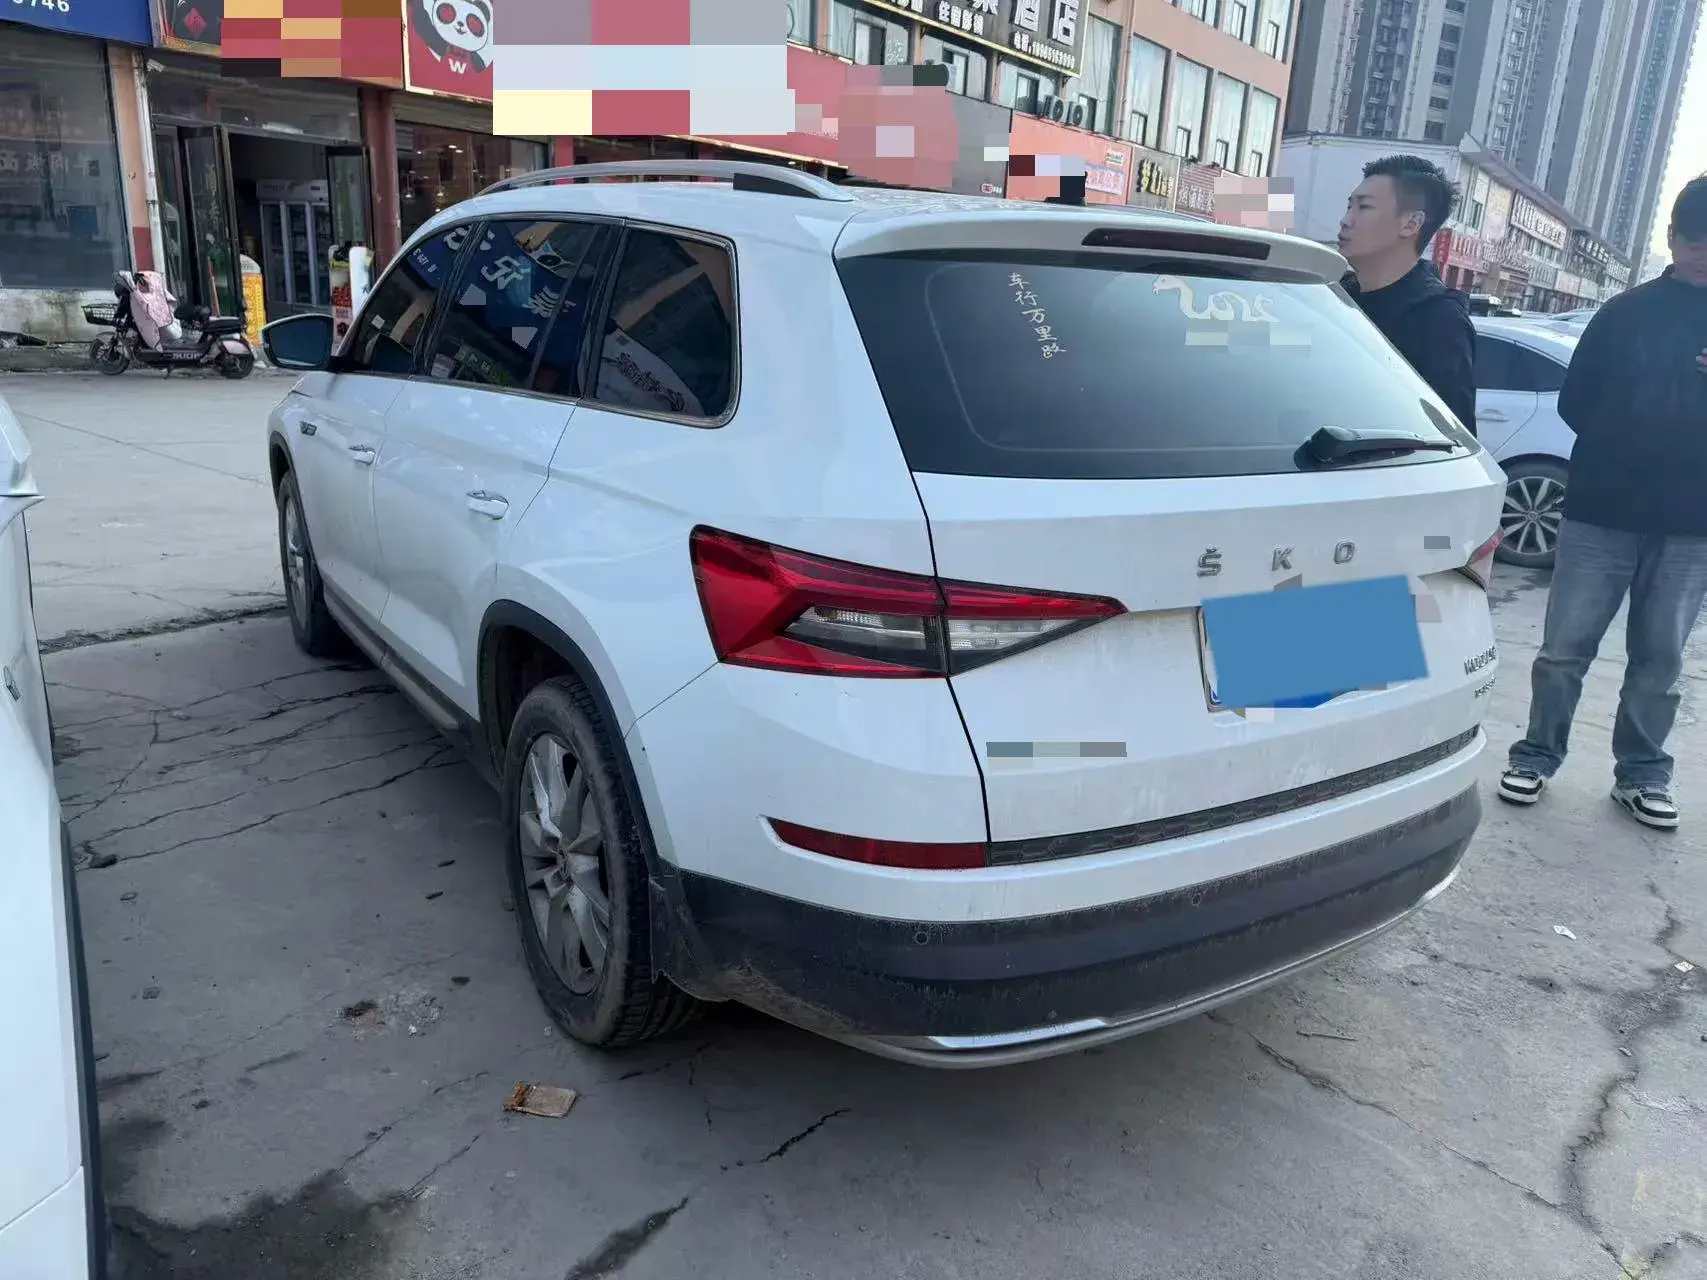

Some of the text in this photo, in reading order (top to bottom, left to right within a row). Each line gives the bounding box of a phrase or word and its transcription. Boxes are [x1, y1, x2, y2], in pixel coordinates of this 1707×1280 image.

[448, 57, 467, 74] W
[1008, 272, 1067, 360] 车行万里路
